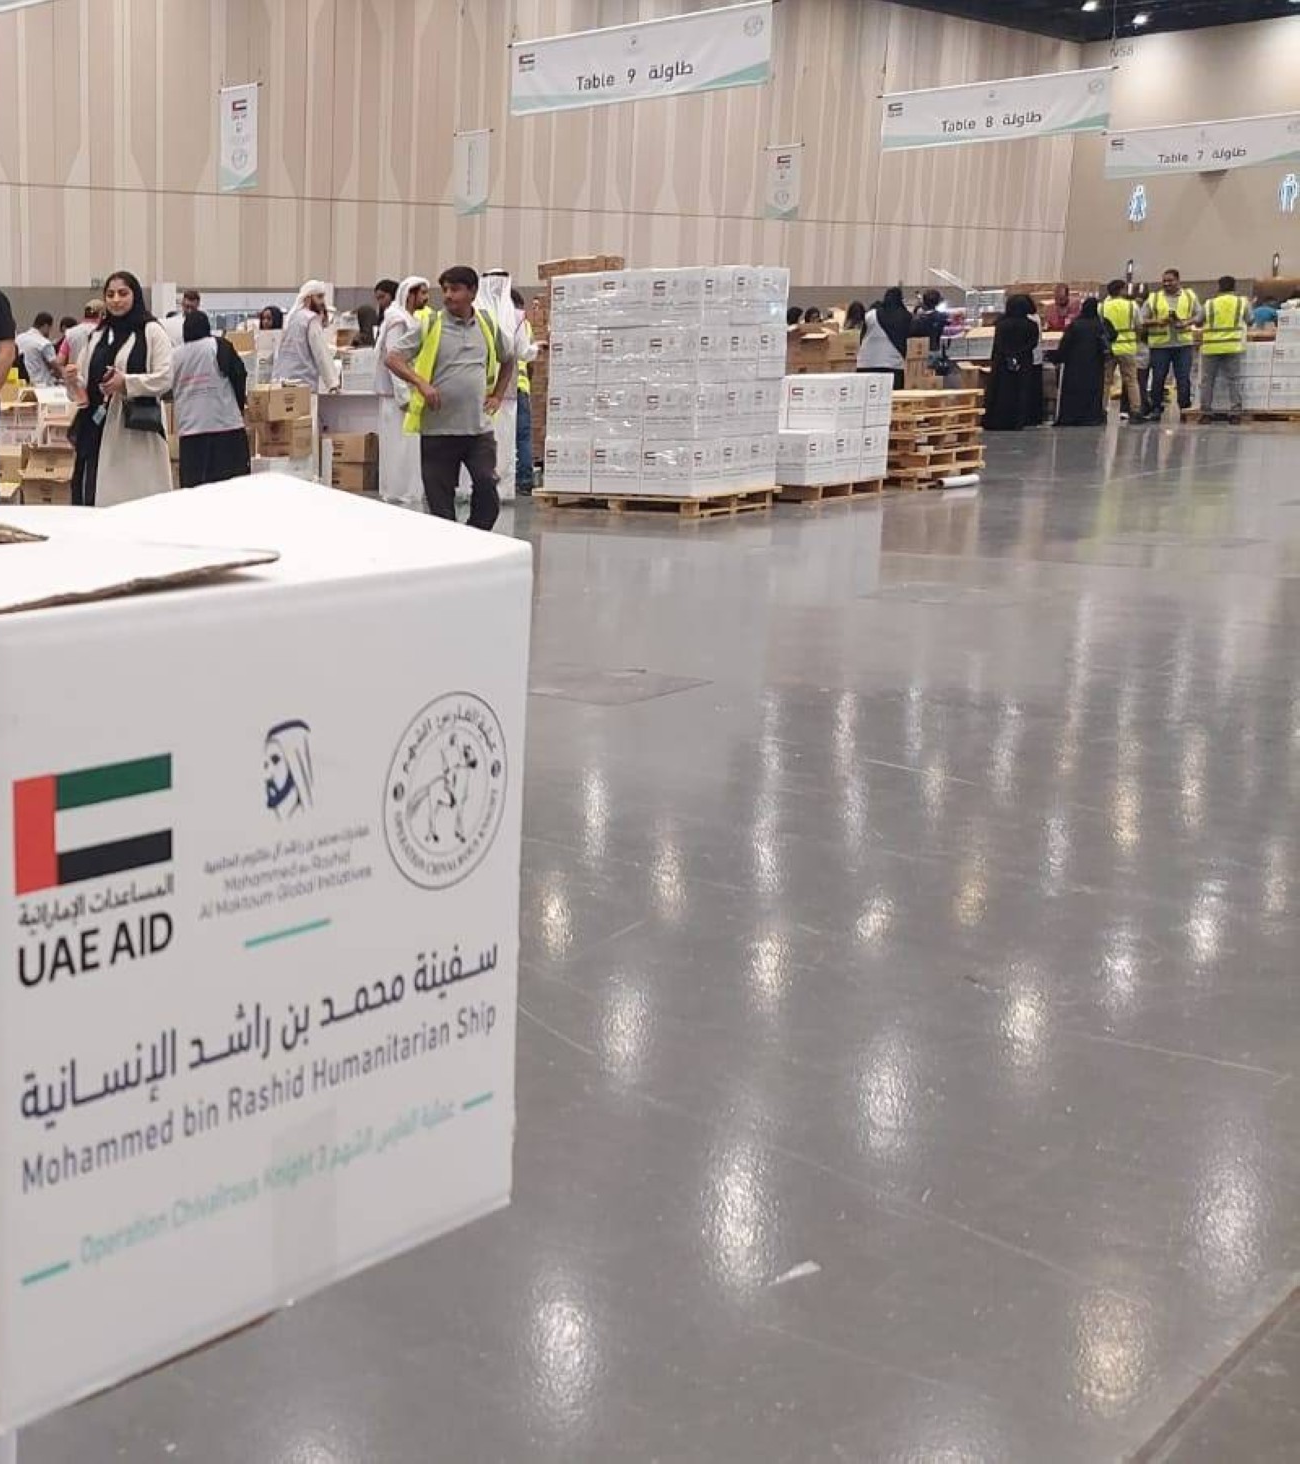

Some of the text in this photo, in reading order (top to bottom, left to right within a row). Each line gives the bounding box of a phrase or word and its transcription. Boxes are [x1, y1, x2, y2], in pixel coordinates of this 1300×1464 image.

[576, 68, 636, 91] Table 9
[649, 61, 693, 83] طاولة
[941, 115, 993, 133] Table 8
[1002, 110, 1042, 129] طاولة
[1157, 153, 1188, 164] Table
[224, 862, 299, 892] Mohammed
[311, 849, 350, 870] Rashid
[89, 872, 175, 914] المساعدات
[199, 866, 372, 921] Al Maktoum Global Initiatives
[18, 912, 173, 987] UAE AID
[20, 943, 498, 1131] سفينة محمد بن راشد الإنسانية
[21, 1002, 497, 1195] Mohammed bin Rashid Humanitarian Ship
[80, 1212, 168, 1264] Operation
[172, 1177, 260, 1228] Chivalrous
[263, 1149, 314, 1189] Knight
